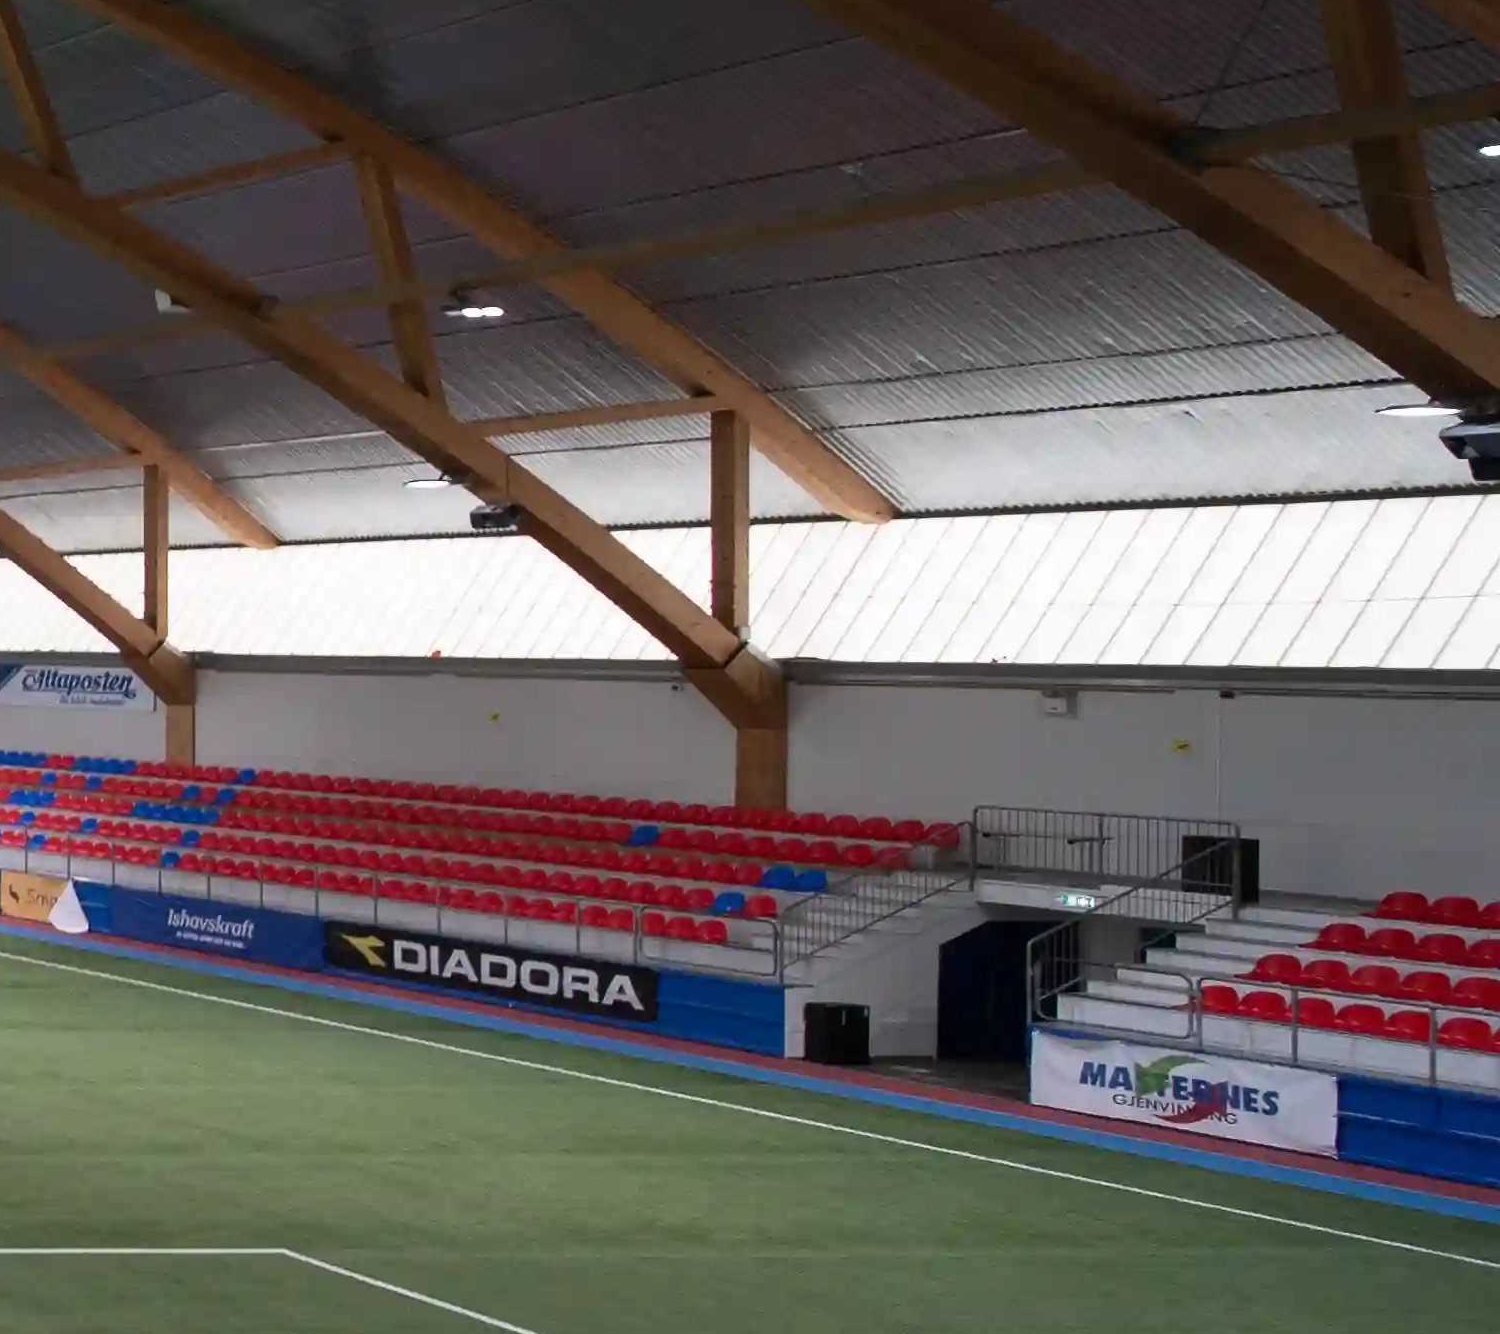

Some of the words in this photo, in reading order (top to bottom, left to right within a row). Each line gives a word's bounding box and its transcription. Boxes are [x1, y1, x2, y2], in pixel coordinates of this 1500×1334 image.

[21, 668, 137, 700] Altaposten
[167, 908, 255, 939] Ishavskraft
[392, 938, 645, 1011] DIADORA
[1079, 1061, 1280, 1117] MAERNES
[1111, 1093, 1238, 1124] GJENVINNG
